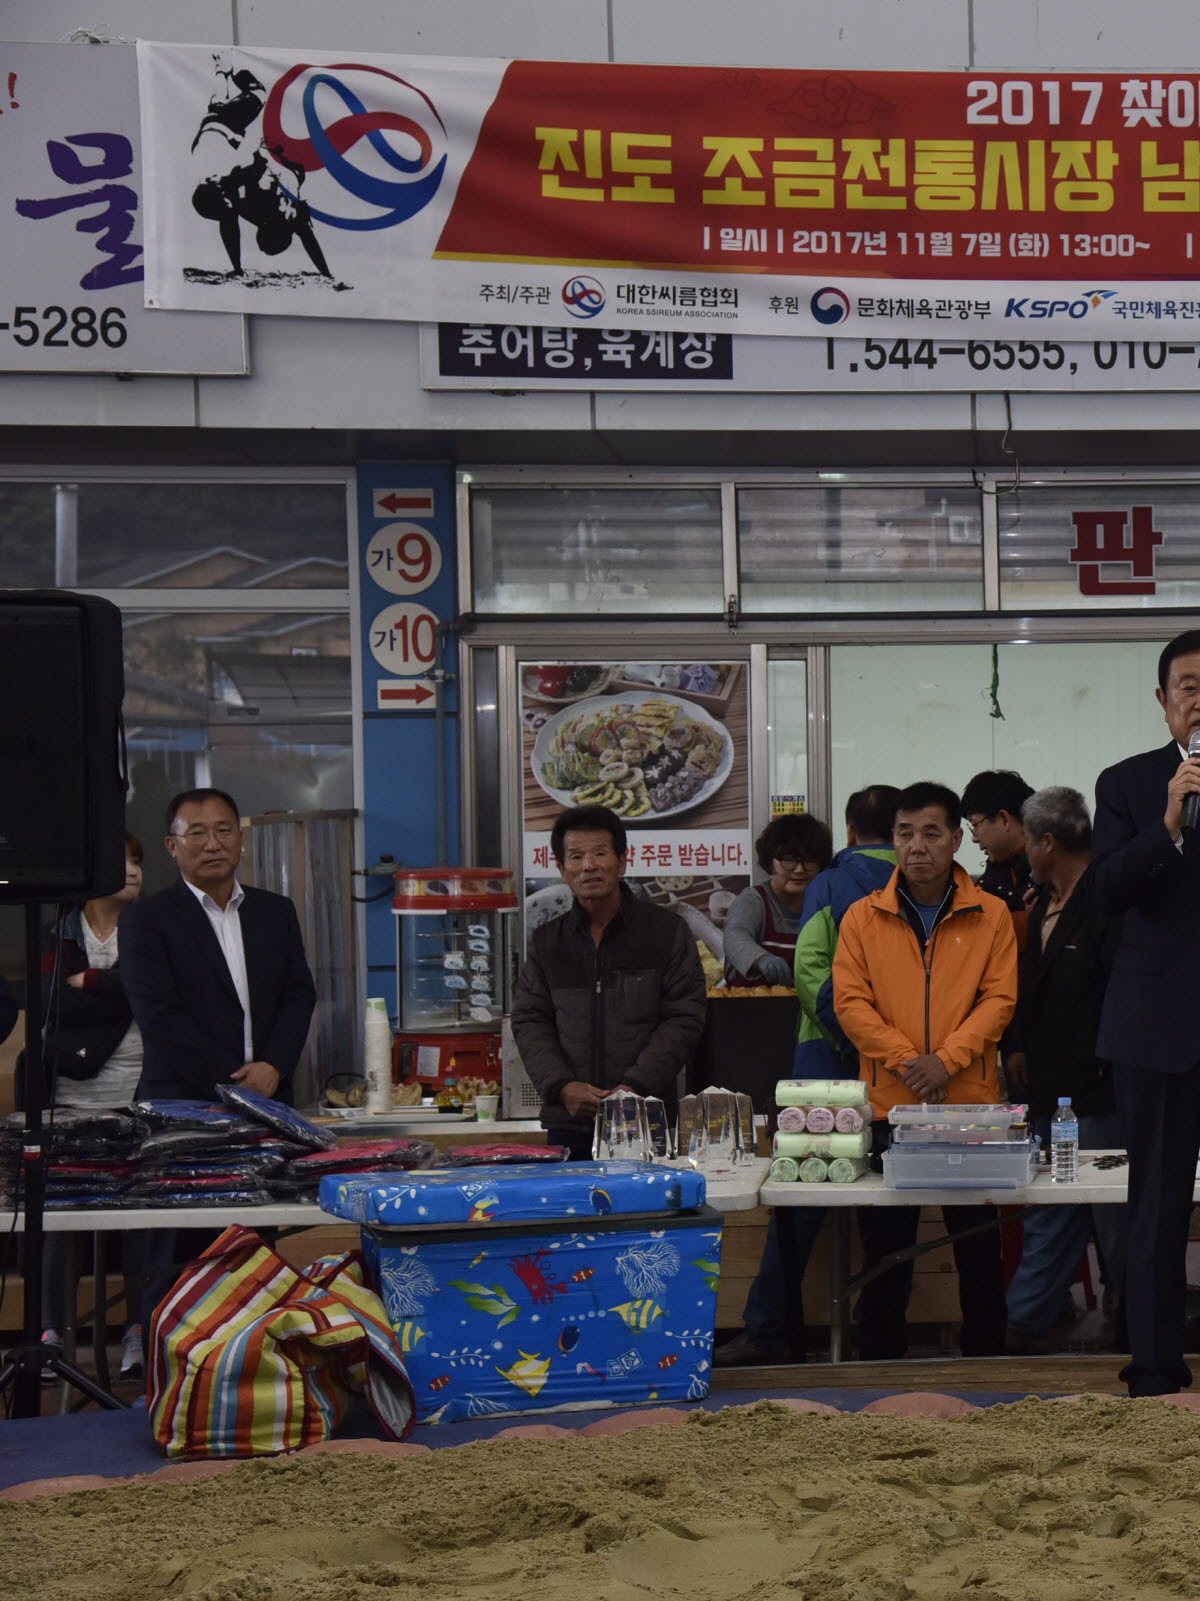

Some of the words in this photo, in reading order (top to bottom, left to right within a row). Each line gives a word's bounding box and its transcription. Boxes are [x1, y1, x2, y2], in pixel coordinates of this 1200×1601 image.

[966, 80, 1103, 126] 2017
[535, 126, 675, 203] 진도
[702, 136, 1119, 213] 조금전통시장
[719, 227, 768, 253] 일시
[792, 230, 887, 256] 2017년
[897, 231, 953, 257] 11월
[961, 232, 1002, 257] 7일
[1008, 232, 1051, 258] (화)
[478, 283, 552, 305] 주최/주관
[615, 283, 739, 309] 대한씨름협회
[616, 307, 644, 316] KOREA
[645, 308, 683, 318] SSIREUM
[684, 310, 739, 319] ASSOCIATION
[768, 295, 800, 315] 후원
[856, 297, 993, 320] 문화체육관광부
[1004, 297, 1091, 319] KSPO
[640, 844, 673, 867] 주문
[678, 842, 748, 867] 받습니다.
